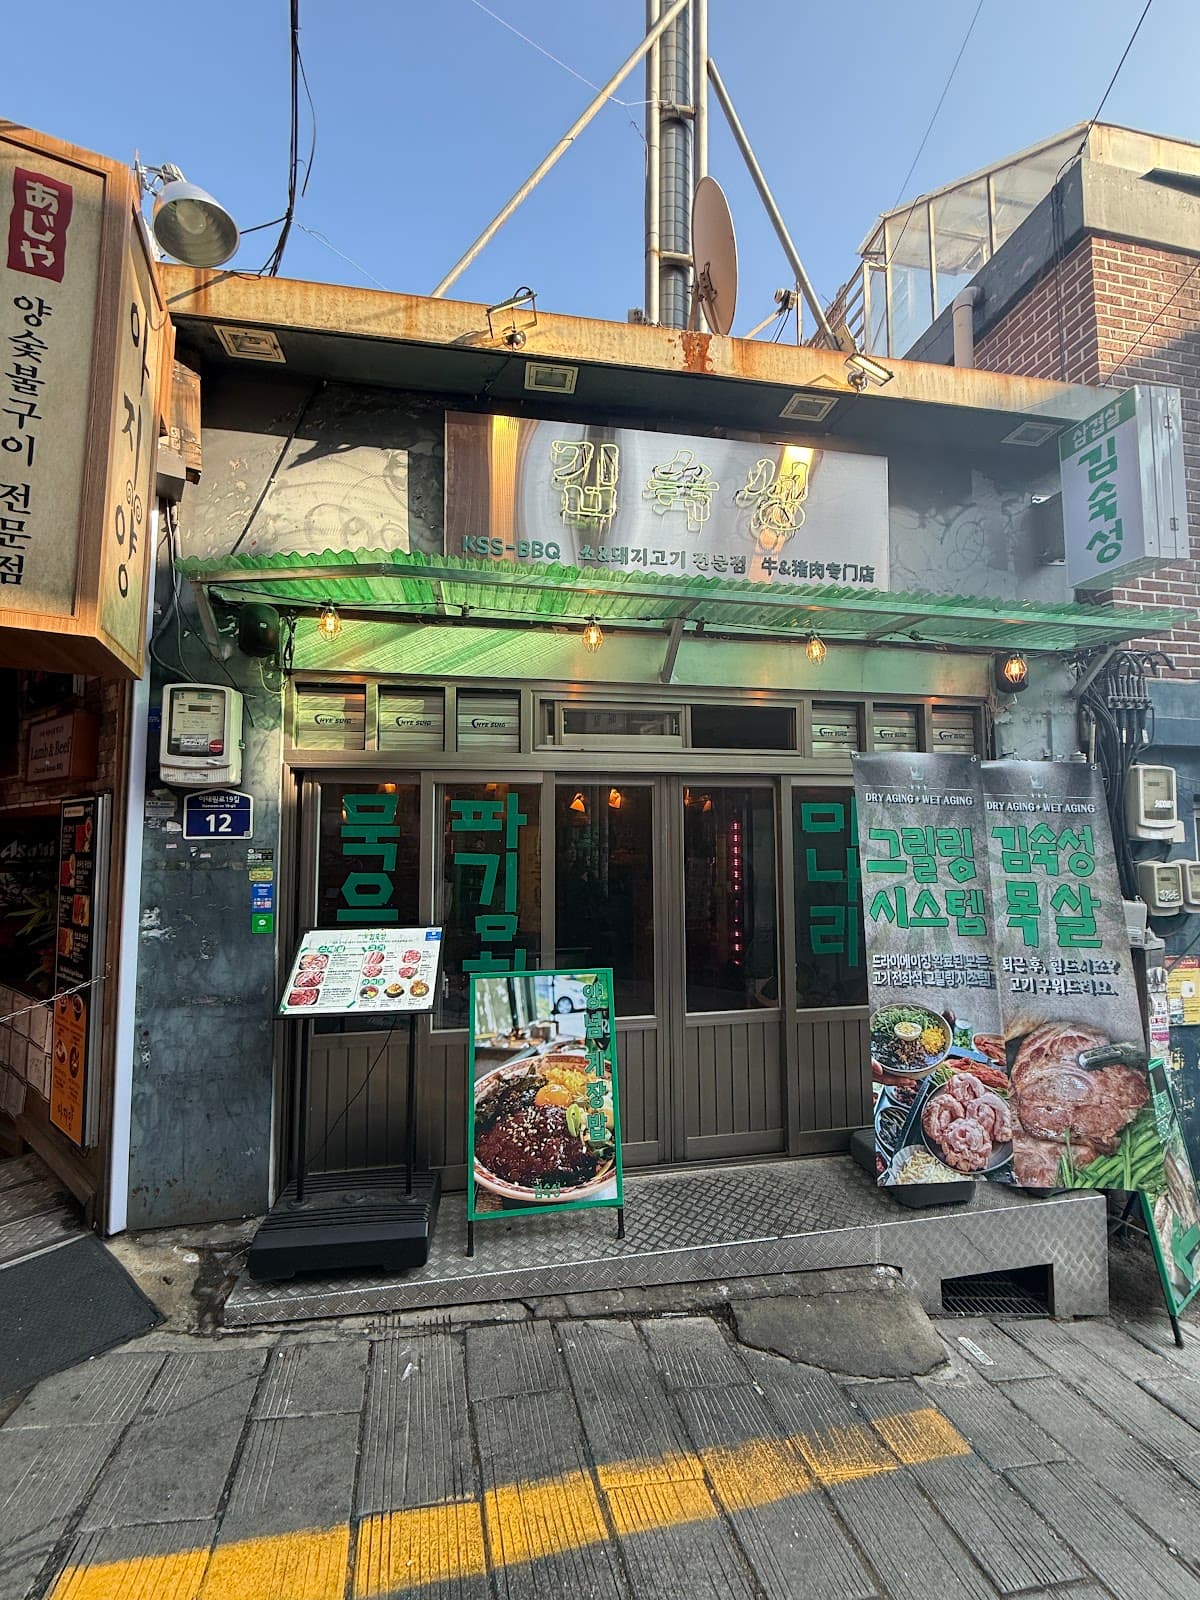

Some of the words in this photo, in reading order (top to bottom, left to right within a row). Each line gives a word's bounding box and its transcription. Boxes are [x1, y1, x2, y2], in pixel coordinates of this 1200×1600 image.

[20, 180, 61, 270] あじや
[2, 294, 53, 468] 양숯불구이
[1077, 436, 1124, 564] 김숙성
[0, 482, 33, 585] 전문점
[462, 535, 561, 560] KSS-BBQ
[761, 557, 876, 584] 牛&猪肉专门店
[206, 813, 232, 832] 12
[865, 792, 884, 803] DRY
[885, 793, 914, 804] AGING
[921, 794, 942, 805] WET
[943, 795, 973, 806] AGING
[986, 801, 1004, 812] DRY
[1006, 802, 1035, 812] AGING
[1042, 803, 1063, 813] WET
[1065, 803, 1095, 814] AGING
[866, 825, 977, 884] 그릴링
[991, 822, 1096, 878] 김숙성
[869, 886, 988, 937] 시스템
[1004, 880, 1104, 949] 목살
